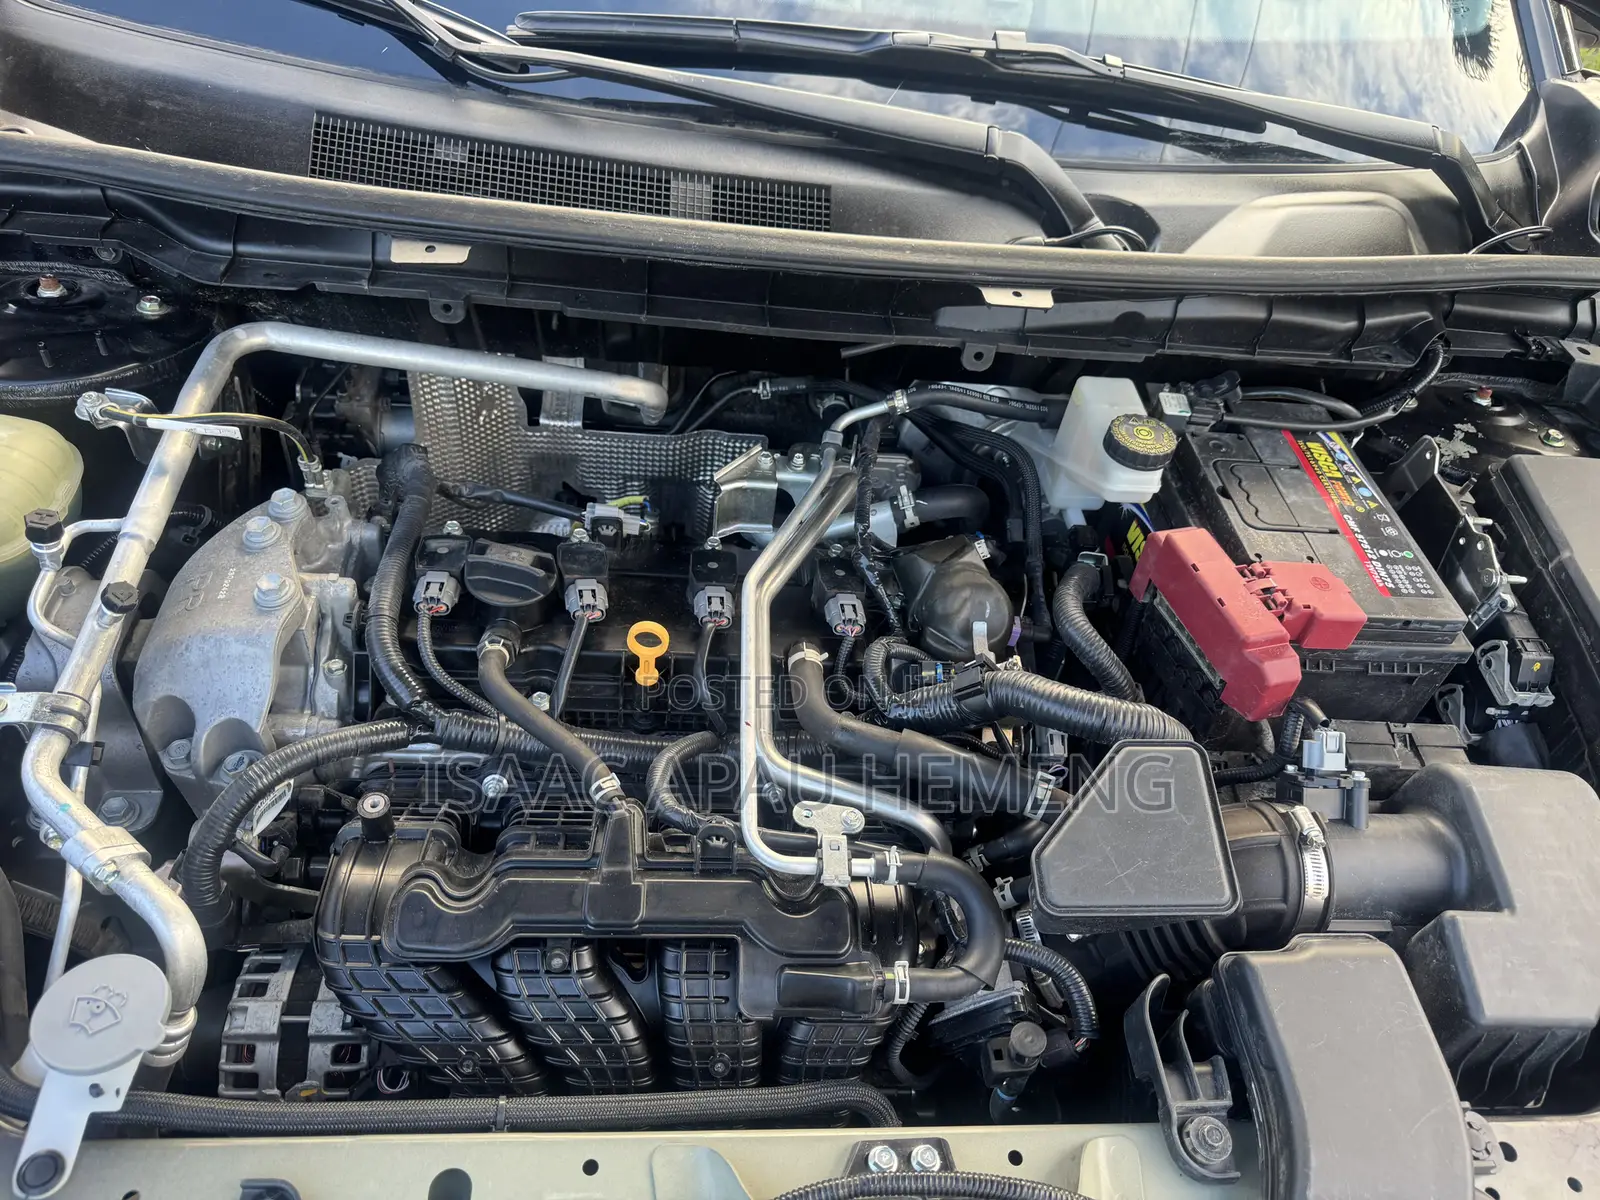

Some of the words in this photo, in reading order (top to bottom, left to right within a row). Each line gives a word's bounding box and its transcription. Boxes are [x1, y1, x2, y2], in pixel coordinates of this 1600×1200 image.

[1305, 441, 1343, 479] VISCA
[1355, 532, 1378, 560] 57512
[1371, 560, 1396, 589] DIN75
